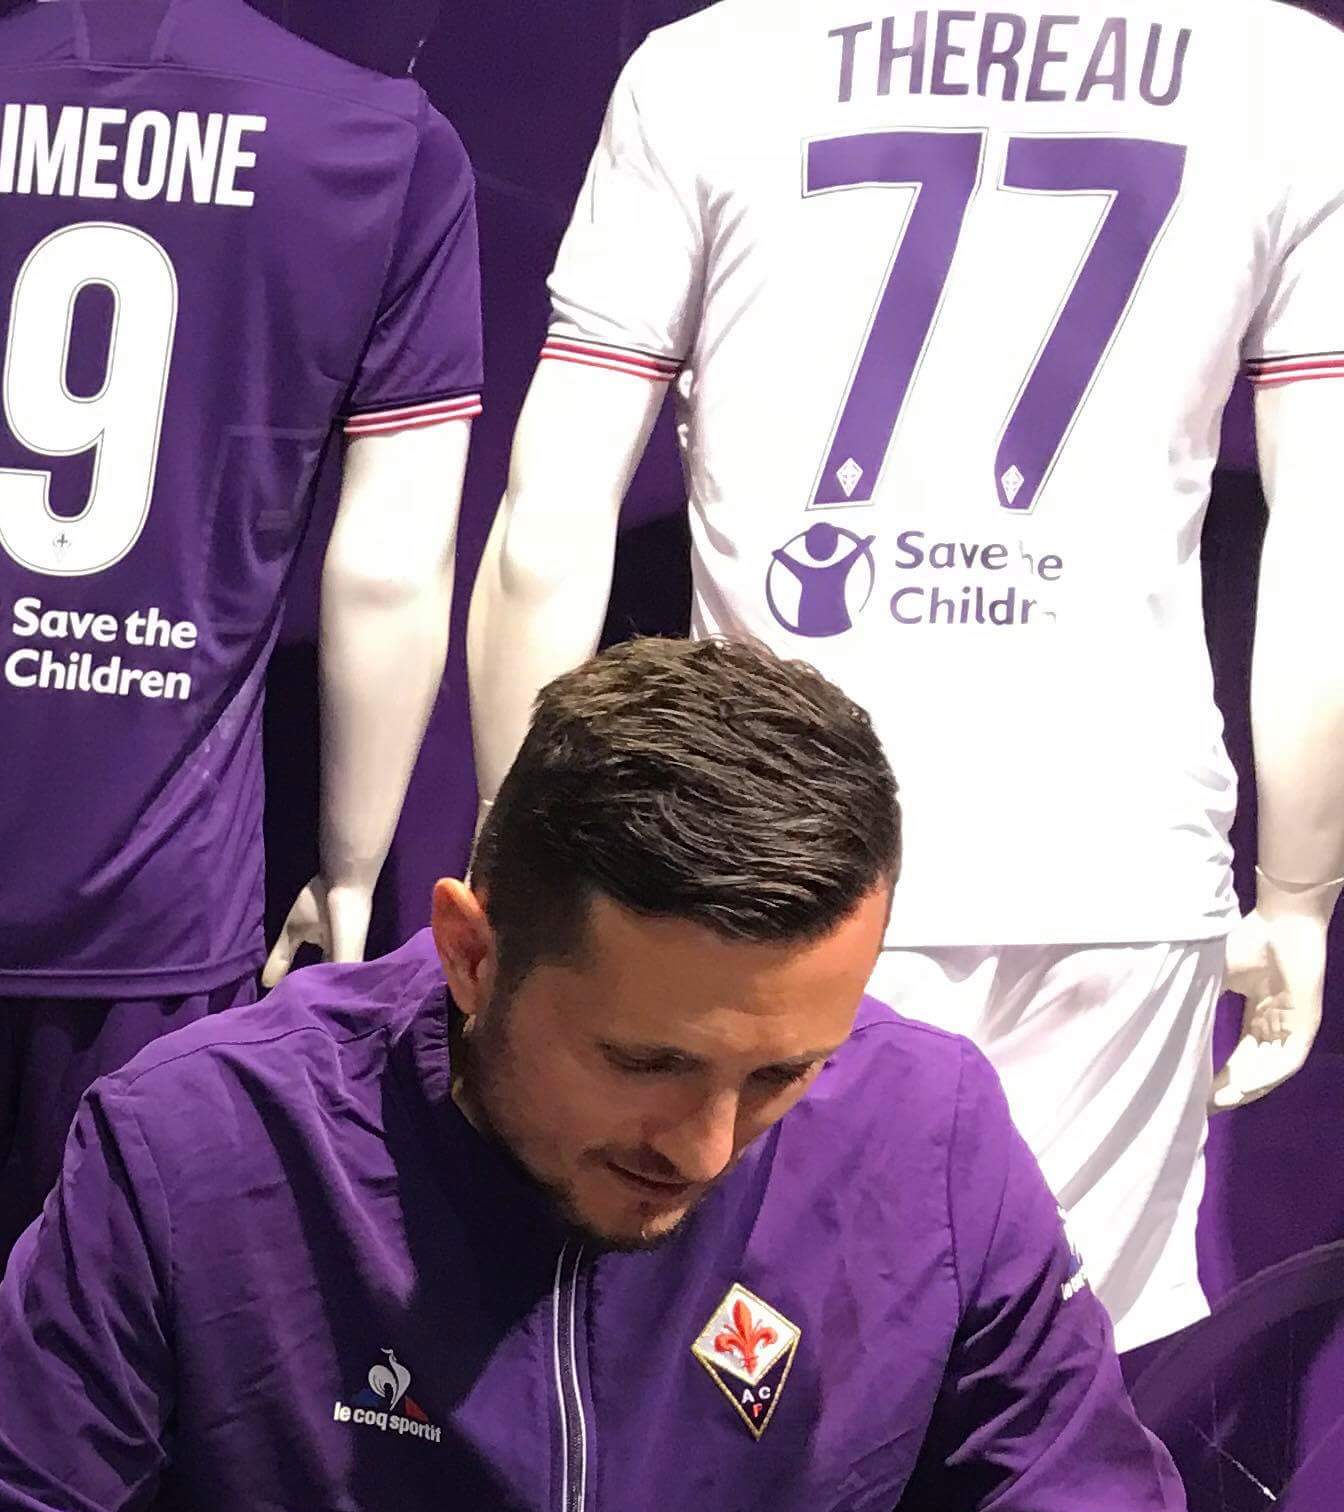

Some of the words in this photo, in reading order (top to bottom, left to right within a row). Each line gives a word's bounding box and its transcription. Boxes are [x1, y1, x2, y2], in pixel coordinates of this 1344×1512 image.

[828, 10, 1192, 106] THEREAU
[801, 126, 1188, 514] 77
[895, 531, 1009, 571] Save
[13, 597, 120, 645] Save
[124, 605, 198, 649] the
[4, 650, 191, 699] Children
[333, 1401, 352, 1422] le
[353, 1408, 389, 1431] coq
[389, 1415, 442, 1443] sportif
